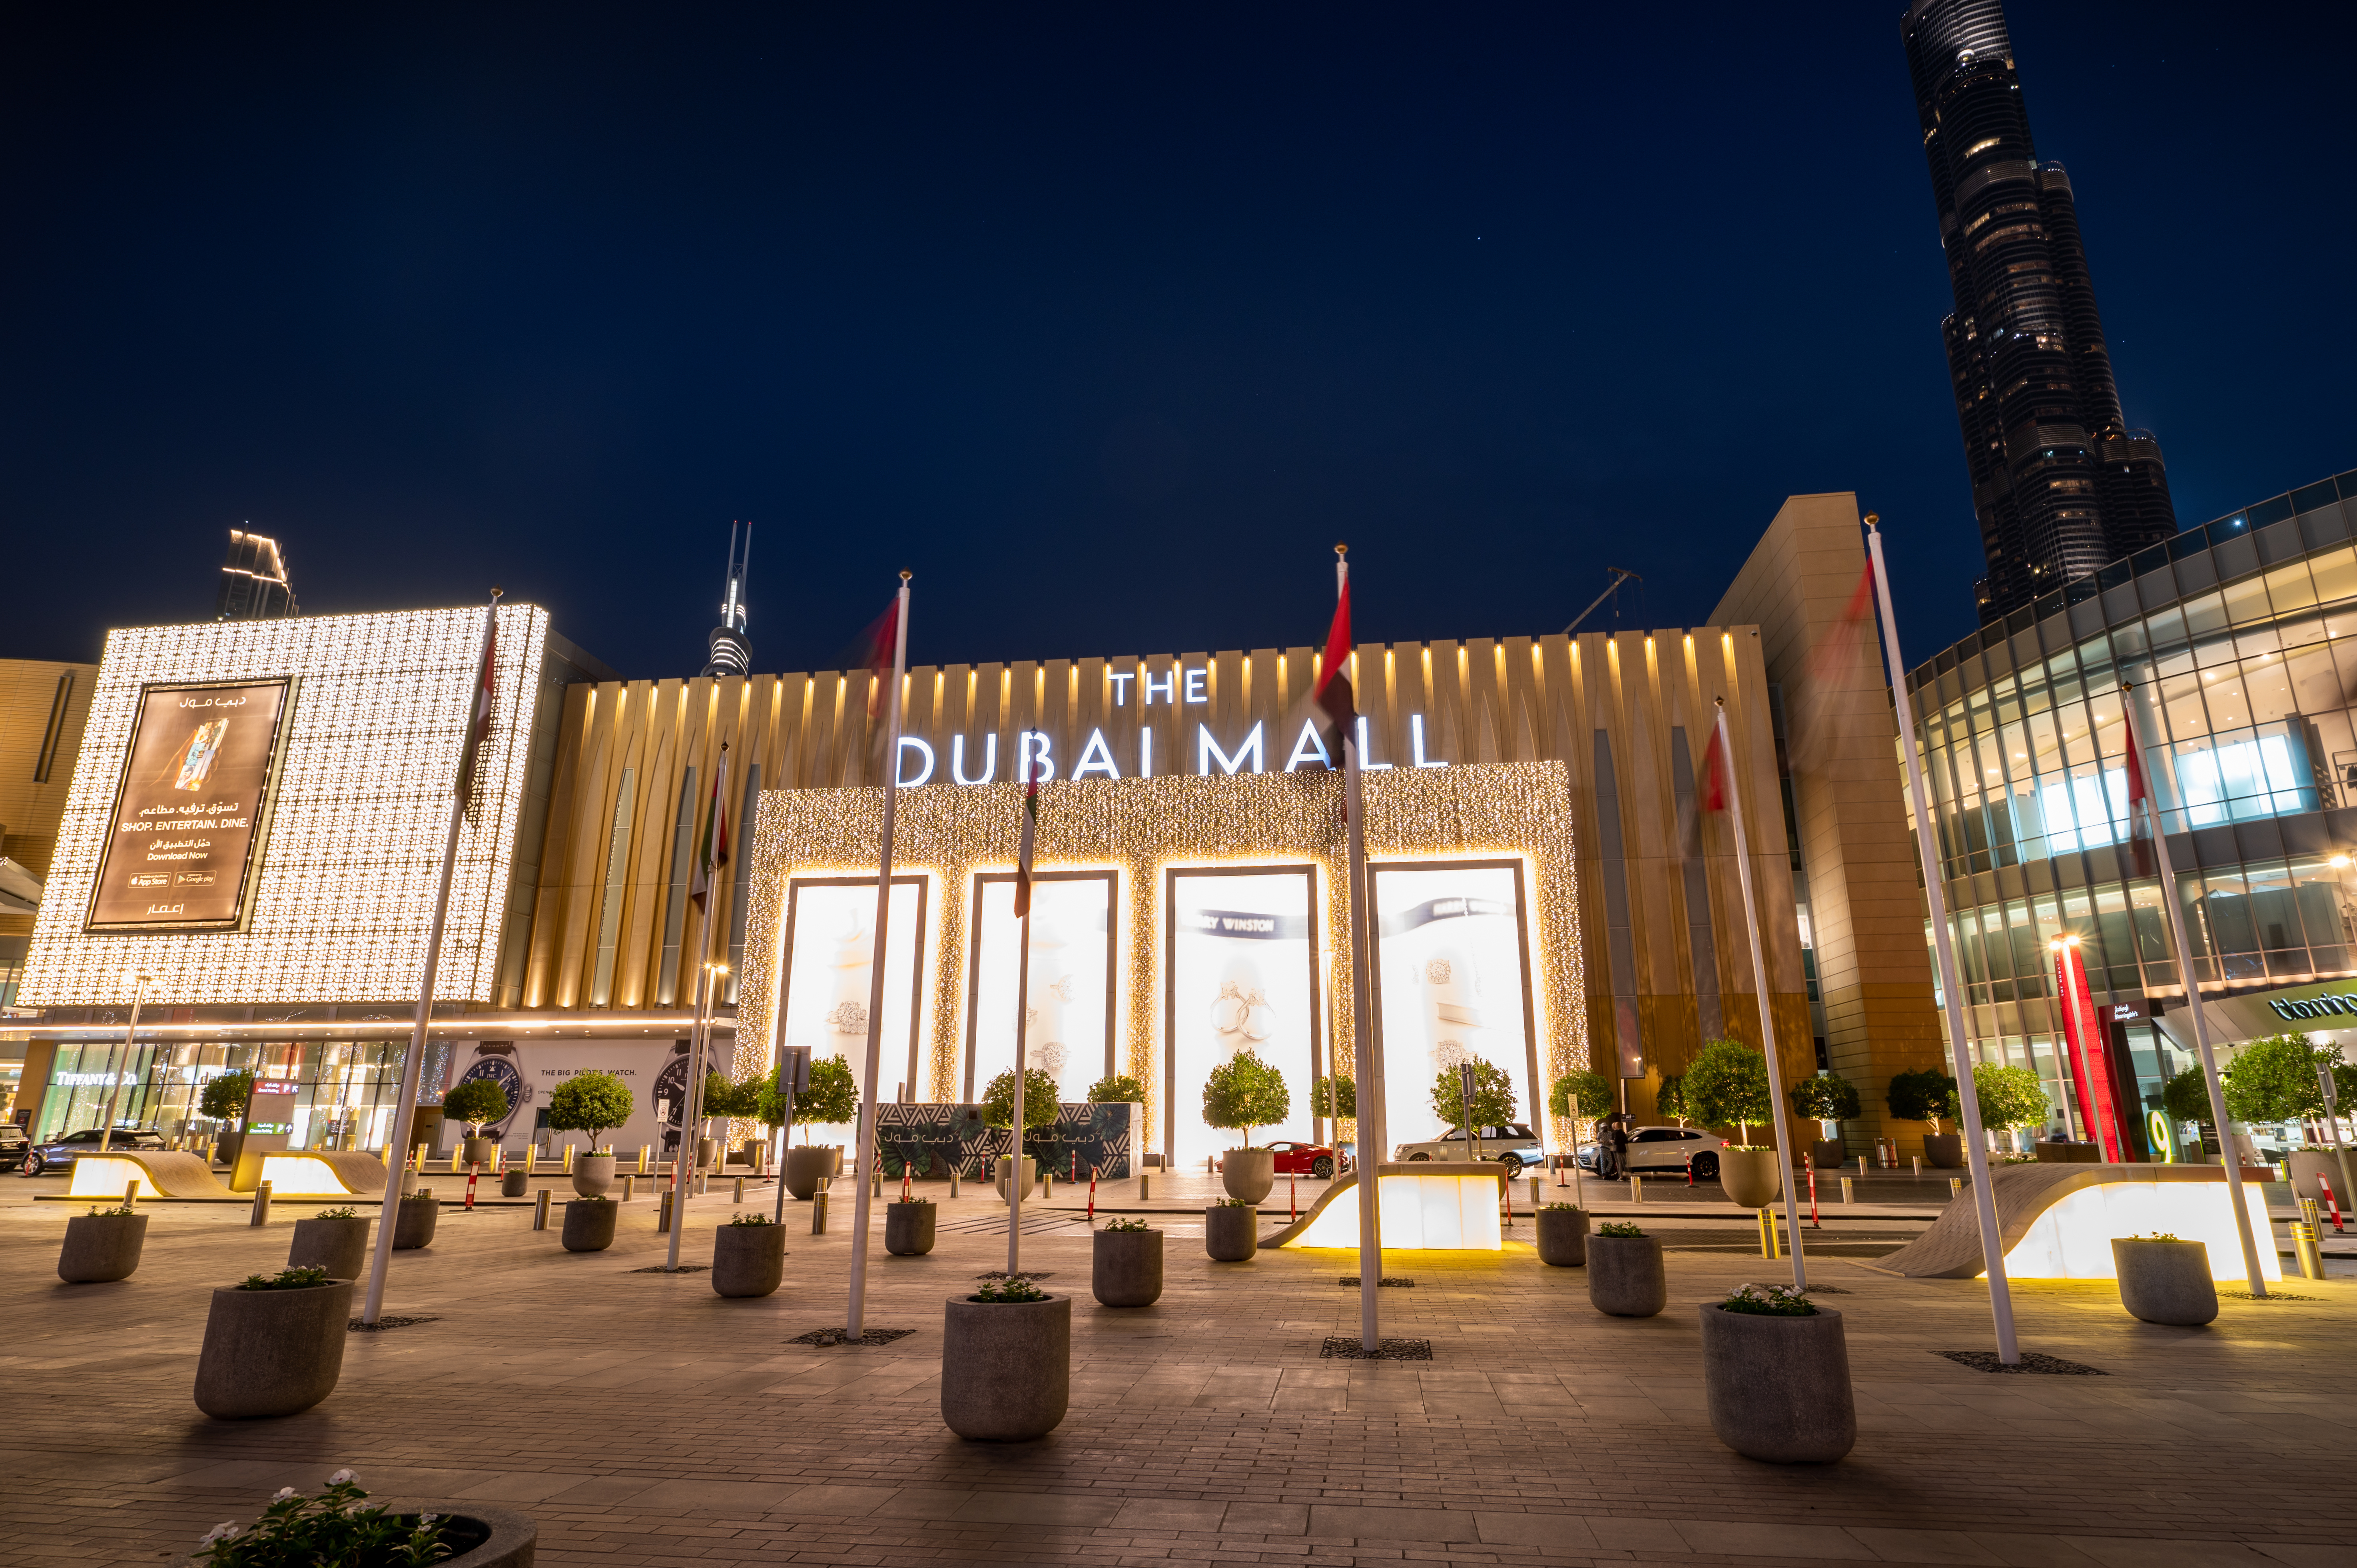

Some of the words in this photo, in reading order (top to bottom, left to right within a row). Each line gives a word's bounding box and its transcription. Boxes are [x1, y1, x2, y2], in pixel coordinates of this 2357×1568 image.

[1108, 669, 1207, 707] THE
[179, 697, 213, 709] مول
[215, 696, 246, 708] دبي
[895, 727, 1151, 787] DUBAI
[1199, 714, 1449, 776] MALL
[139, 805, 175, 817] مطاعم.
[121, 821, 153, 832] SHOP.
[155, 819, 218, 831] ENTERTAIN.
[220, 818, 249, 828] DINE.
[150, 839, 162, 850] الآن
[163, 839, 194, 850] التطبيق
[147, 852, 188, 861] Download
[146, 903, 184, 915] إعمار
[1222, 918, 1274, 932] WINSTON
[56, 1071, 107, 1086] TIFFANY
[105, 1072, 117, 1086] &
[884, 1132, 918, 1144] مول
[922, 1134, 953, 1145] دبي
[1023, 1131, 1058, 1144] مول
[1062, 1134, 1095, 1145] دبي
[2147, 1111, 2172, 1164] 9
